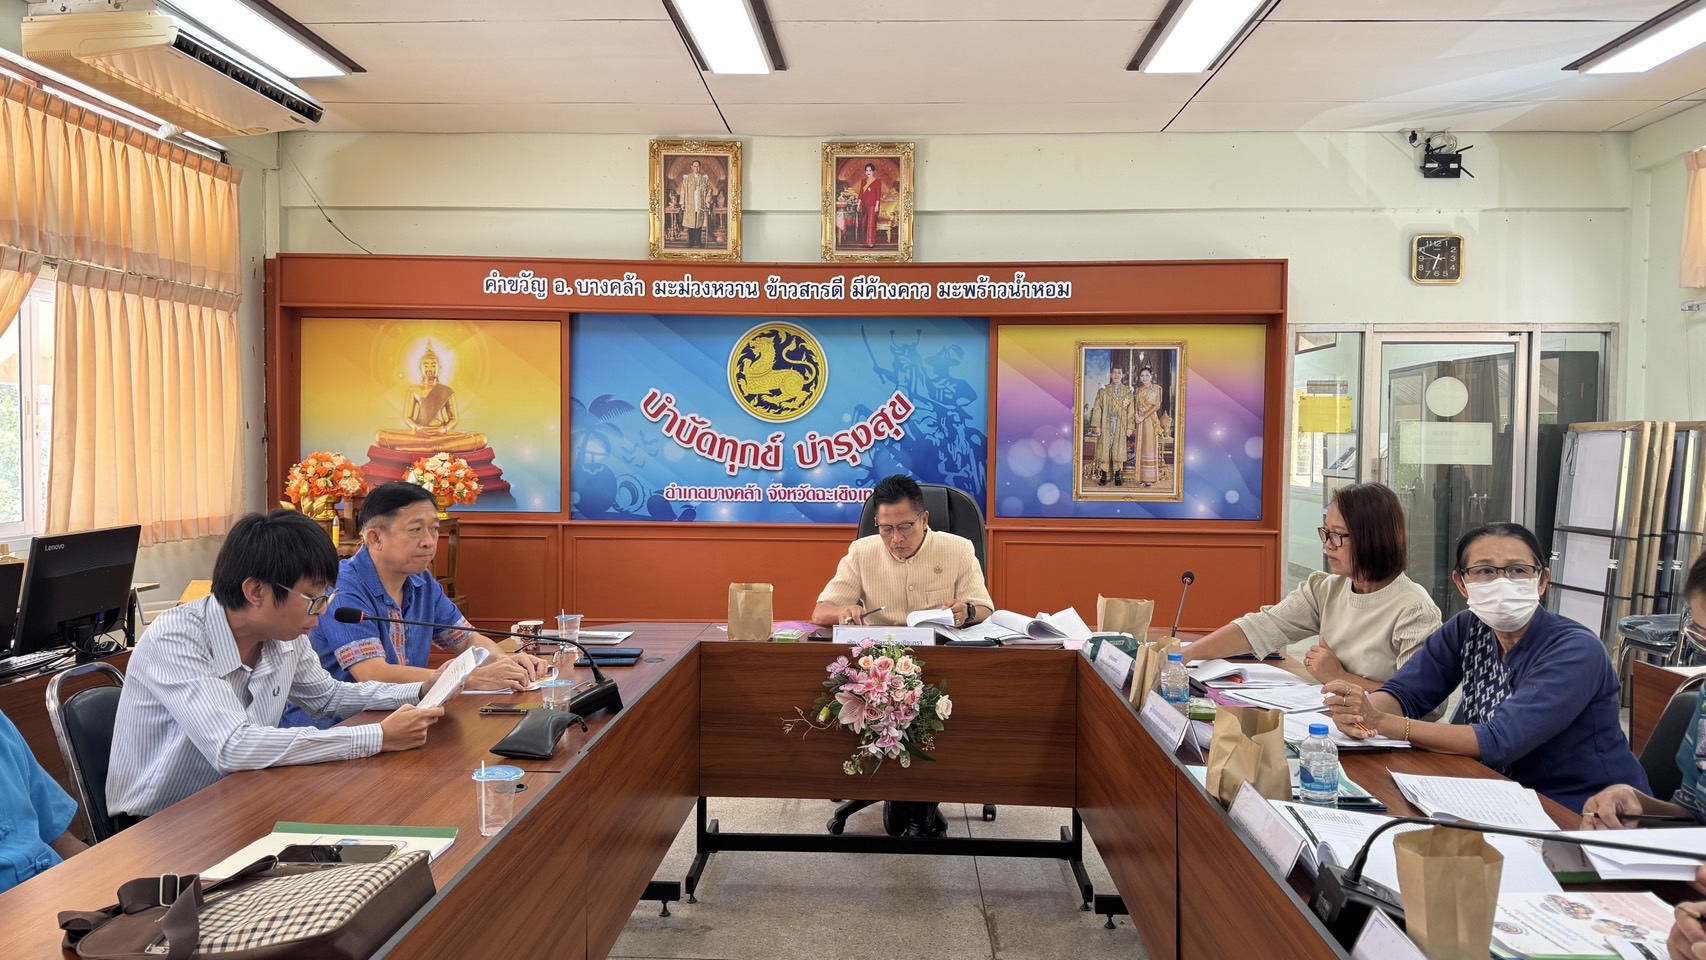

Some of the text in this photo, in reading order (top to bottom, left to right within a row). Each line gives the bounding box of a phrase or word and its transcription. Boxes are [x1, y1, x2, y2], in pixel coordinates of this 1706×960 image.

[484, 270, 1072, 300] คำขวัญ อ. บางคล้า มะม่วงหวาน ข้าวสารดี มีค้างคาว มะพร้าวน้ำหอม
[640, 388, 916, 476] บำบัดทุกข์ บำรุงสุข
[664, 482, 875, 504] อำเภอบางคล้า จังหวัดฉะเชิงเท
